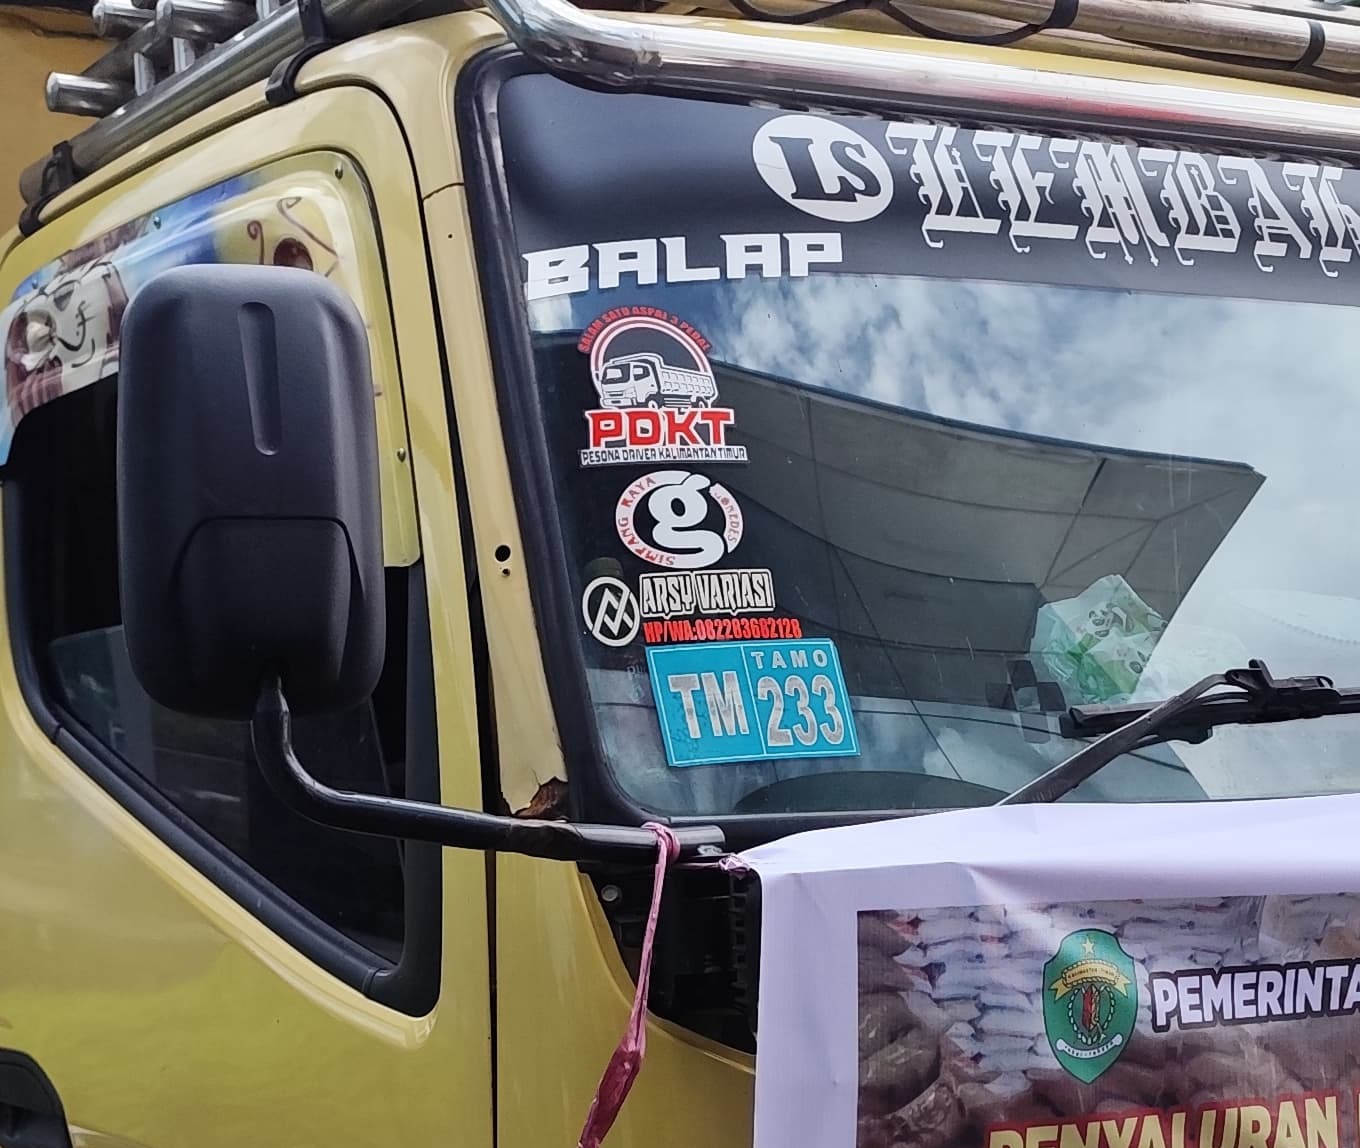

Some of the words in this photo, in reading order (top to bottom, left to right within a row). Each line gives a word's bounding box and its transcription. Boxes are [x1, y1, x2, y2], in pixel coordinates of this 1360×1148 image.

[521, 231, 843, 300] BALAP
[601, 306, 630, 322] SATU
[588, 410, 733, 447] PDKT
[582, 449, 620, 466] PESONA
[623, 448, 656, 462] DRIVER
[659, 447, 717, 461] KALIMANTAN
[719, 447, 746, 460] TIMUR
[642, 575, 694, 615] ARSY
[694, 571, 774, 612] VARIASI
[751, 649, 828, 669] TAMO
[668, 671, 749, 739] TM
[756, 674, 845, 747] 233
